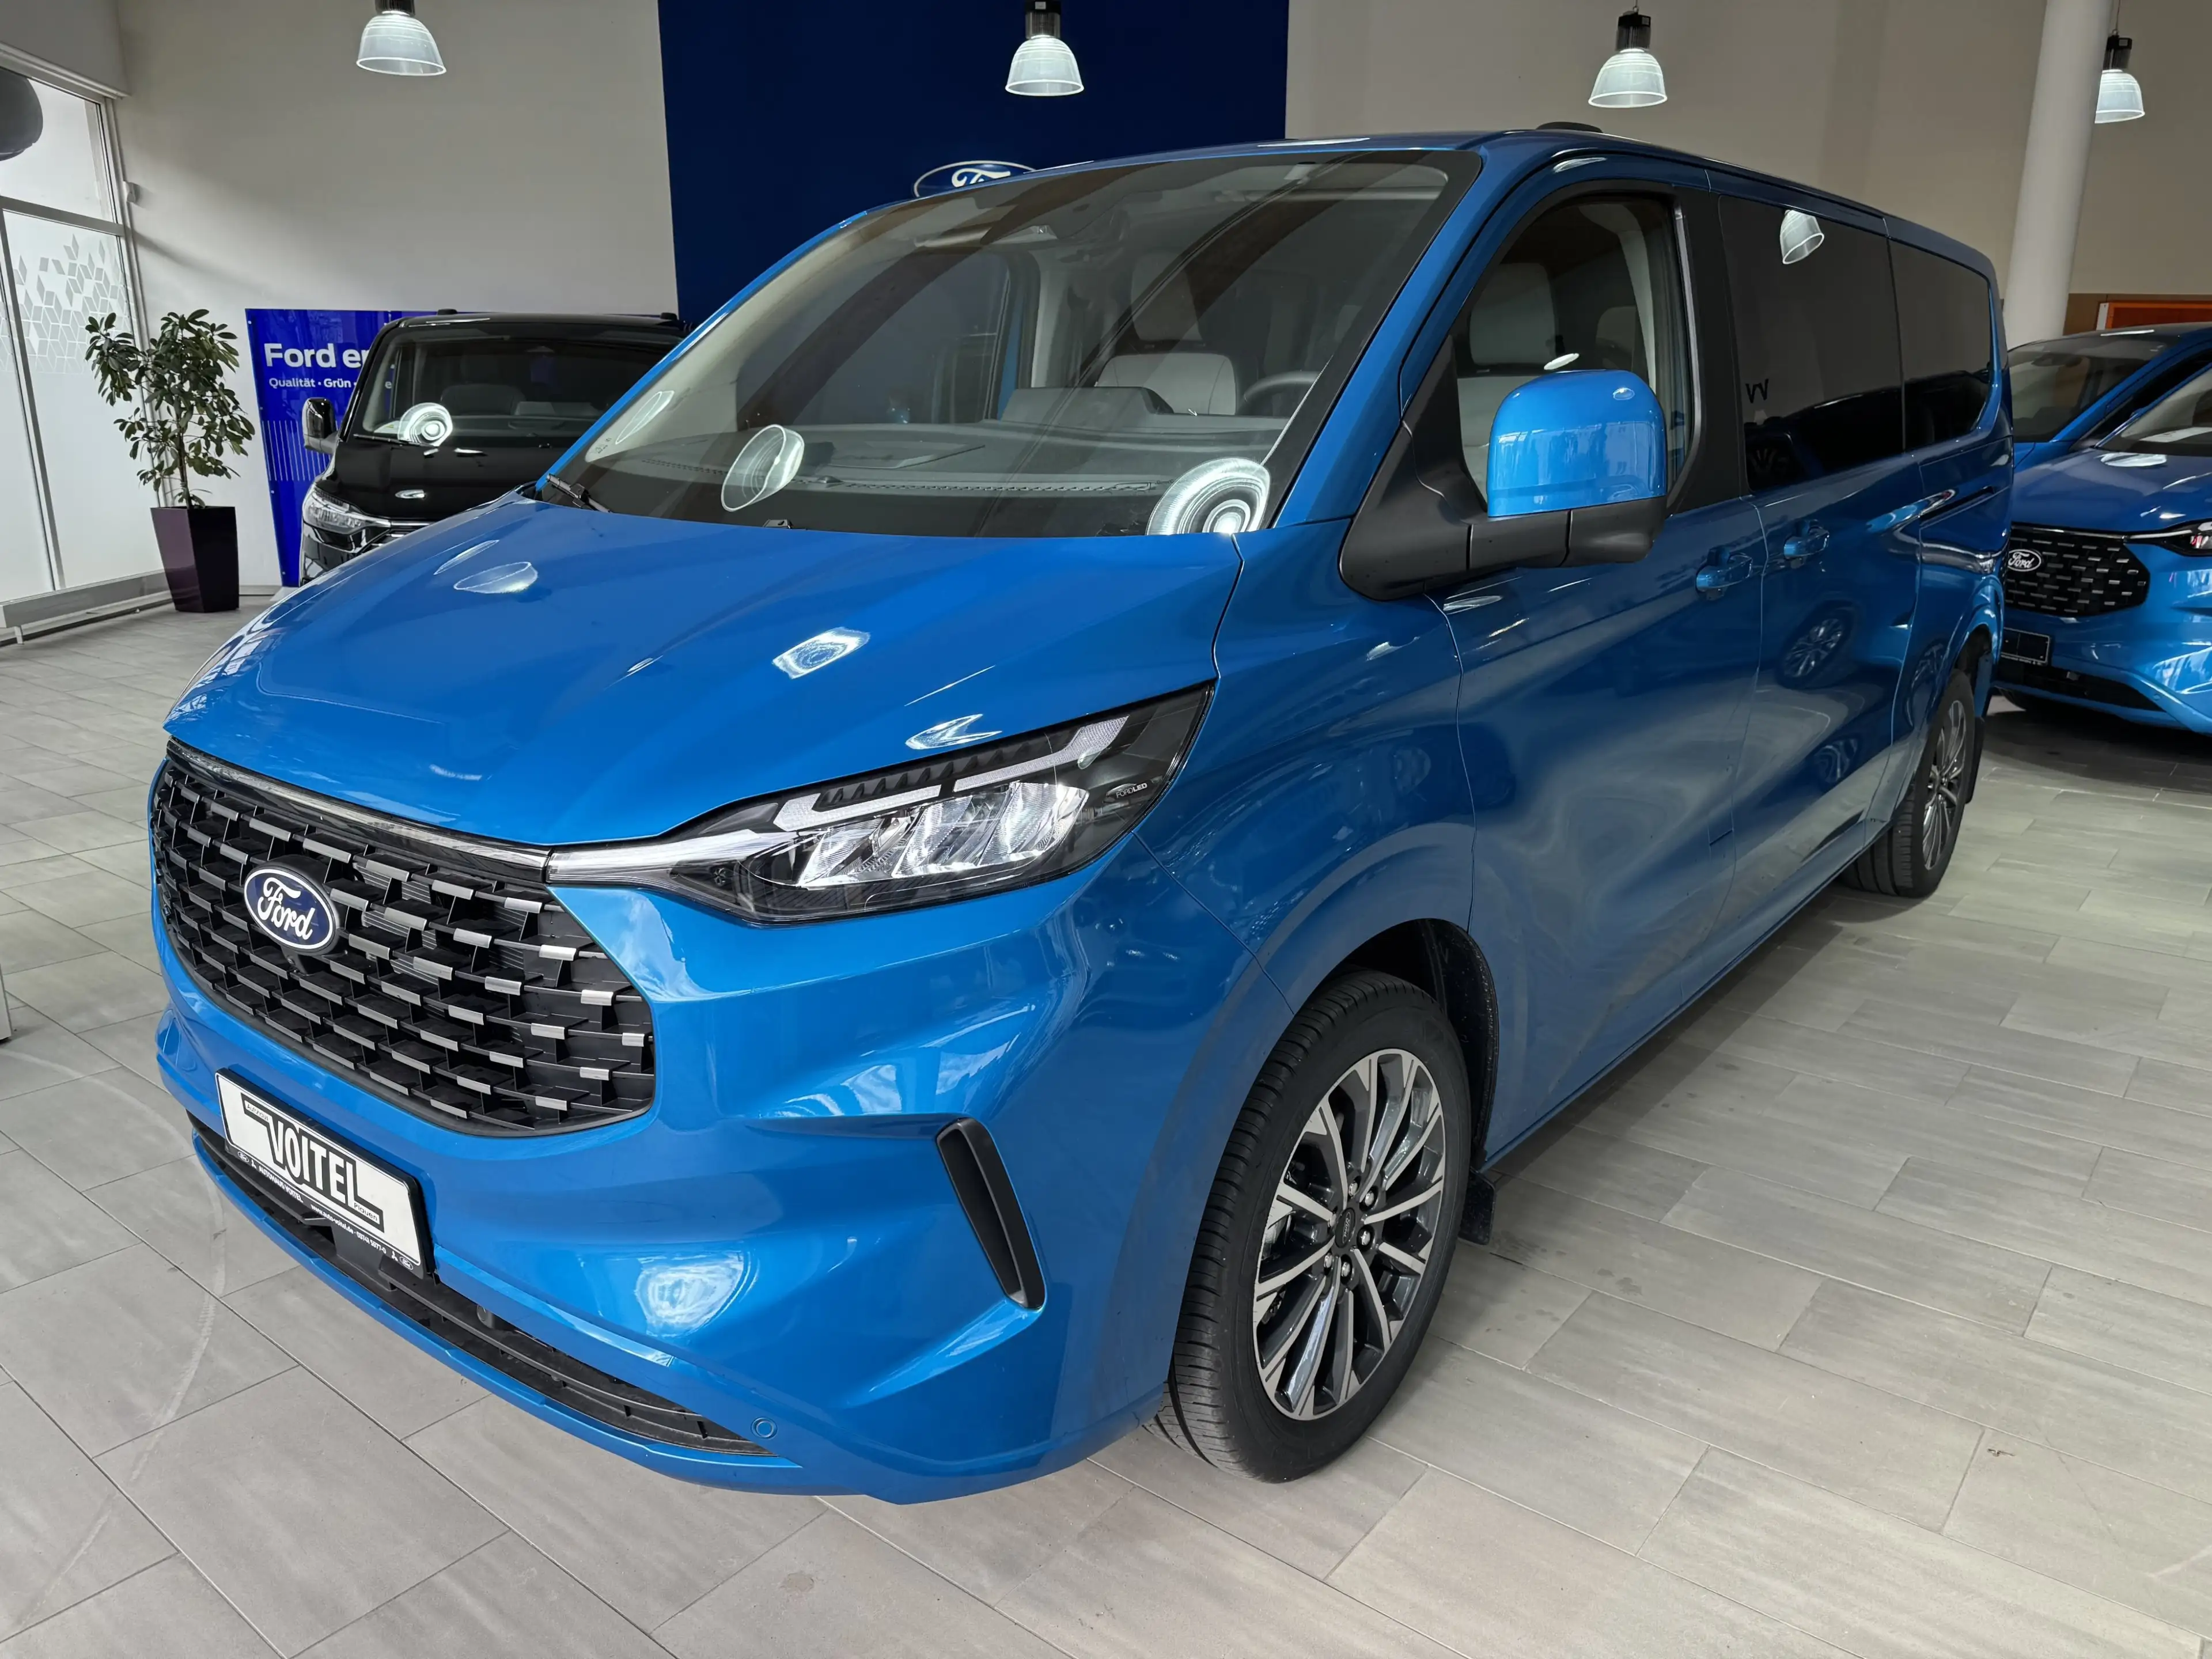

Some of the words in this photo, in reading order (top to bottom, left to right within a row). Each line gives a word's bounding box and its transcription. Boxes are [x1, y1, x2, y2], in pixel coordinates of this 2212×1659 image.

[264, 343, 336, 368] Ford
[268, 377, 316, 389] Qualität
[323, 378, 351, 388] Grün
[2008, 551, 2035, 568] Ford
[257, 877, 316, 940] Ford
[259, 1165, 285, 1190] AUTOHAUS
[284, 1184, 304, 1203] VOITEL
[270, 1119, 381, 1225] VOITEL
[354, 1202, 378, 1222] Plauen
